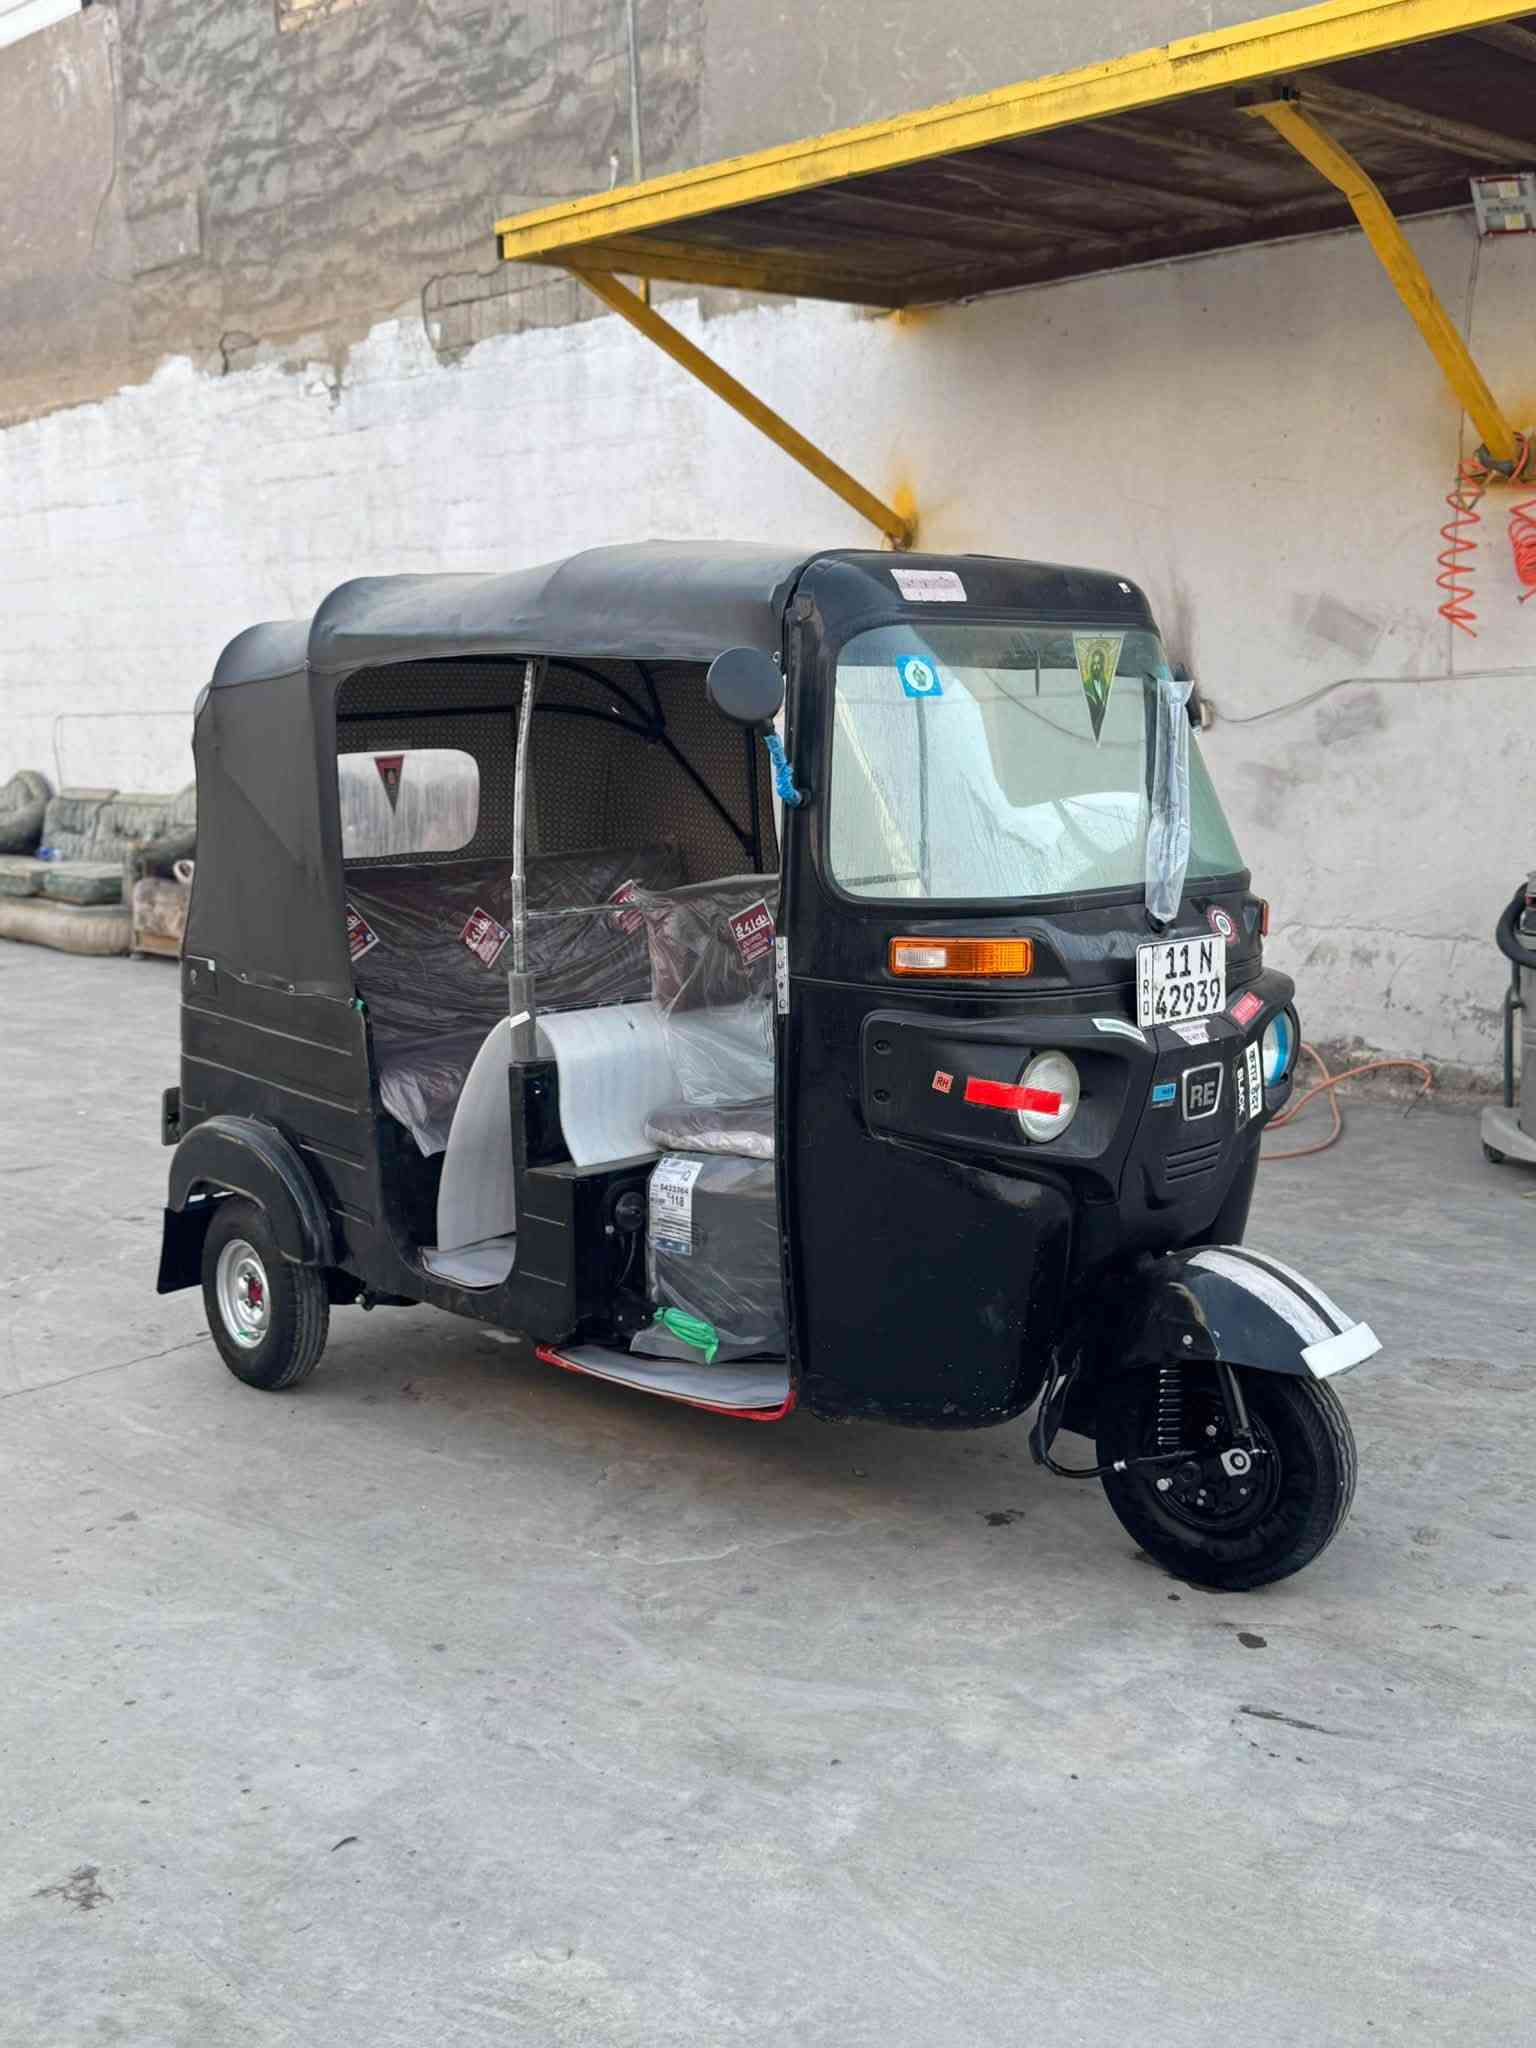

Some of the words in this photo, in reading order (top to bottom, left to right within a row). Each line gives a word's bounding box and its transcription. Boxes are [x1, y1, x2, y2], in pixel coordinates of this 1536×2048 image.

[1165, 944, 1191, 979] 11
[1200, 941, 1212, 974] N
[1155, 977, 1220, 1019] 42939
[936, 1076, 949, 1089] RH
[1189, 1081, 1216, 1109] RE
[1236, 1067, 1246, 1116] BLACK
